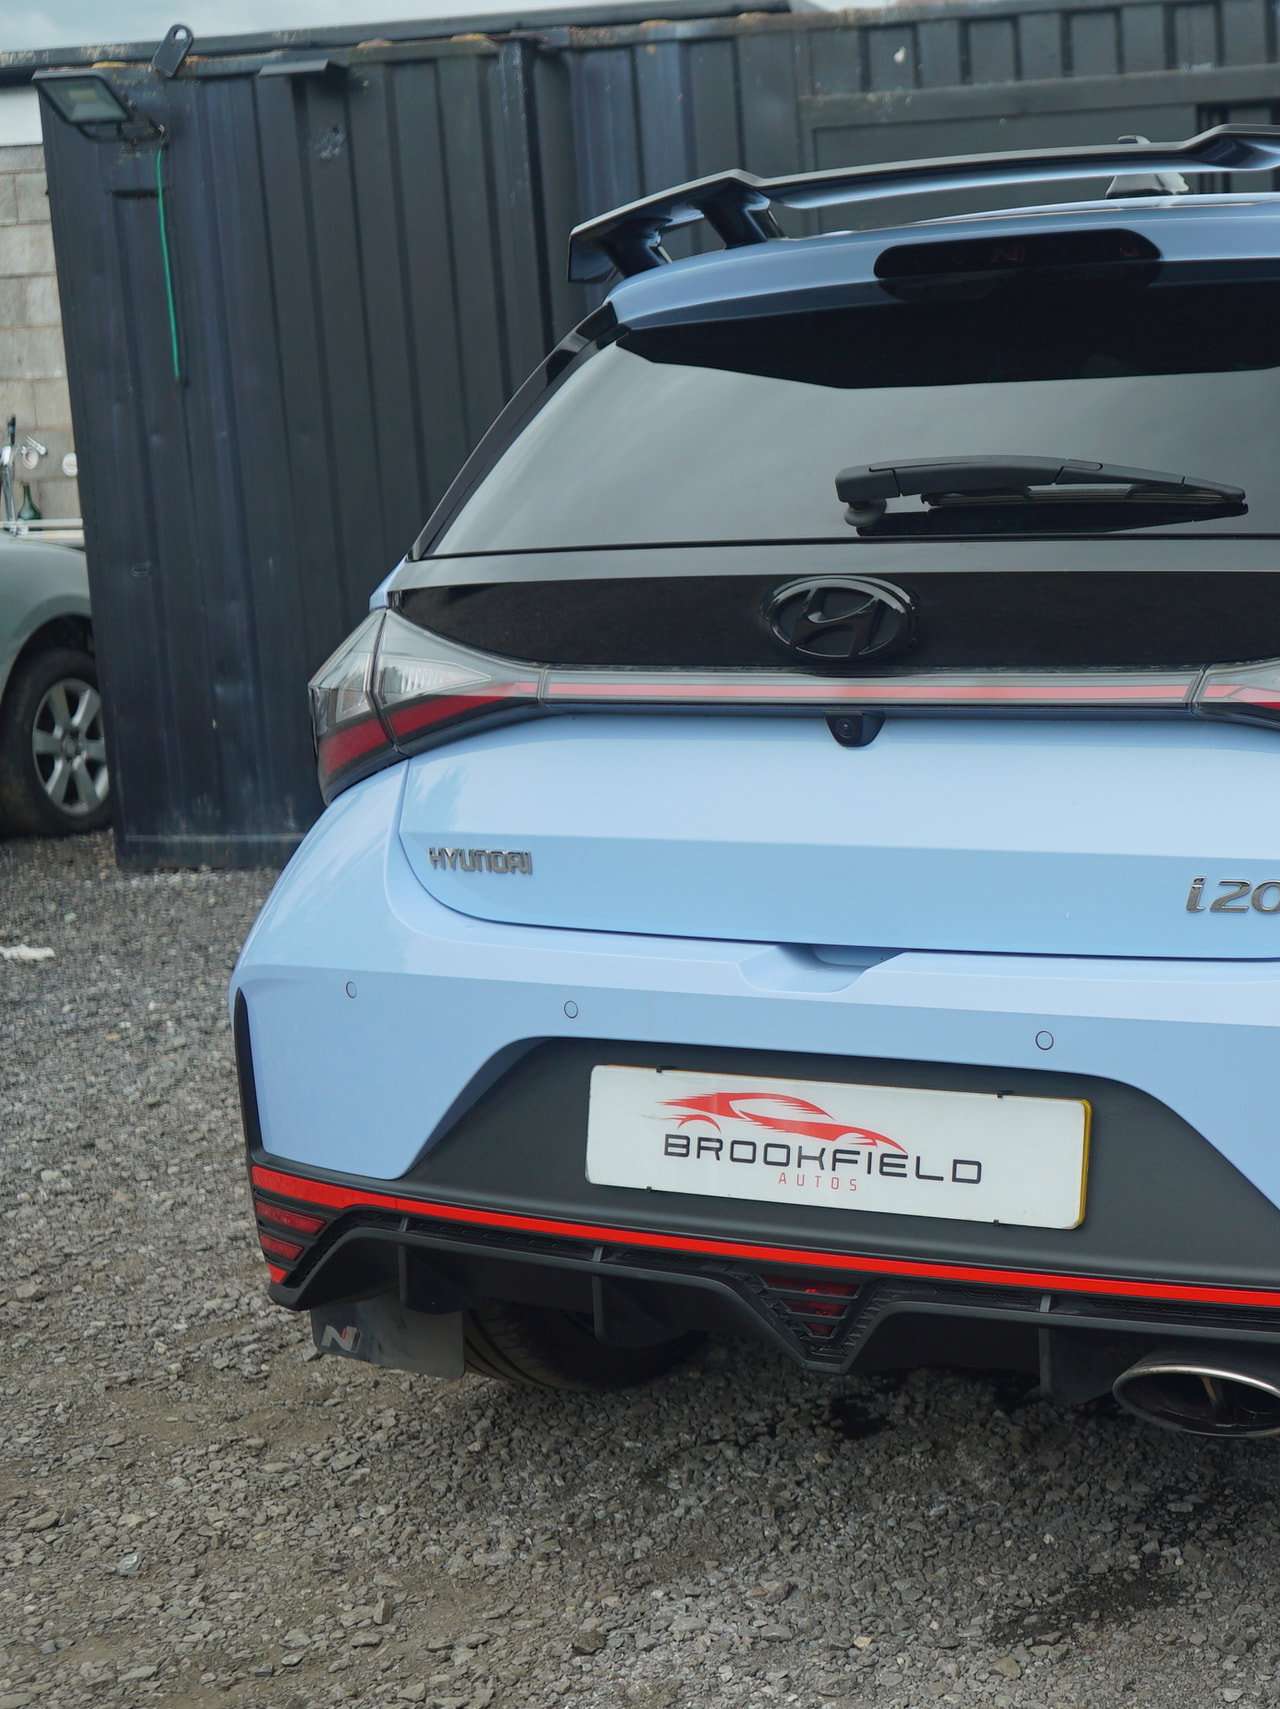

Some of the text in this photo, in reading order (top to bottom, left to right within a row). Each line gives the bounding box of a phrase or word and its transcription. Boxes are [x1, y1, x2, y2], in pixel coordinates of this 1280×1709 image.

[428, 847, 533, 875] HYUNDAI
[663, 1132, 982, 1185] BROOKFIELD
[778, 1171, 857, 1192] AUTOS
[321, 1324, 361, 1354] N
